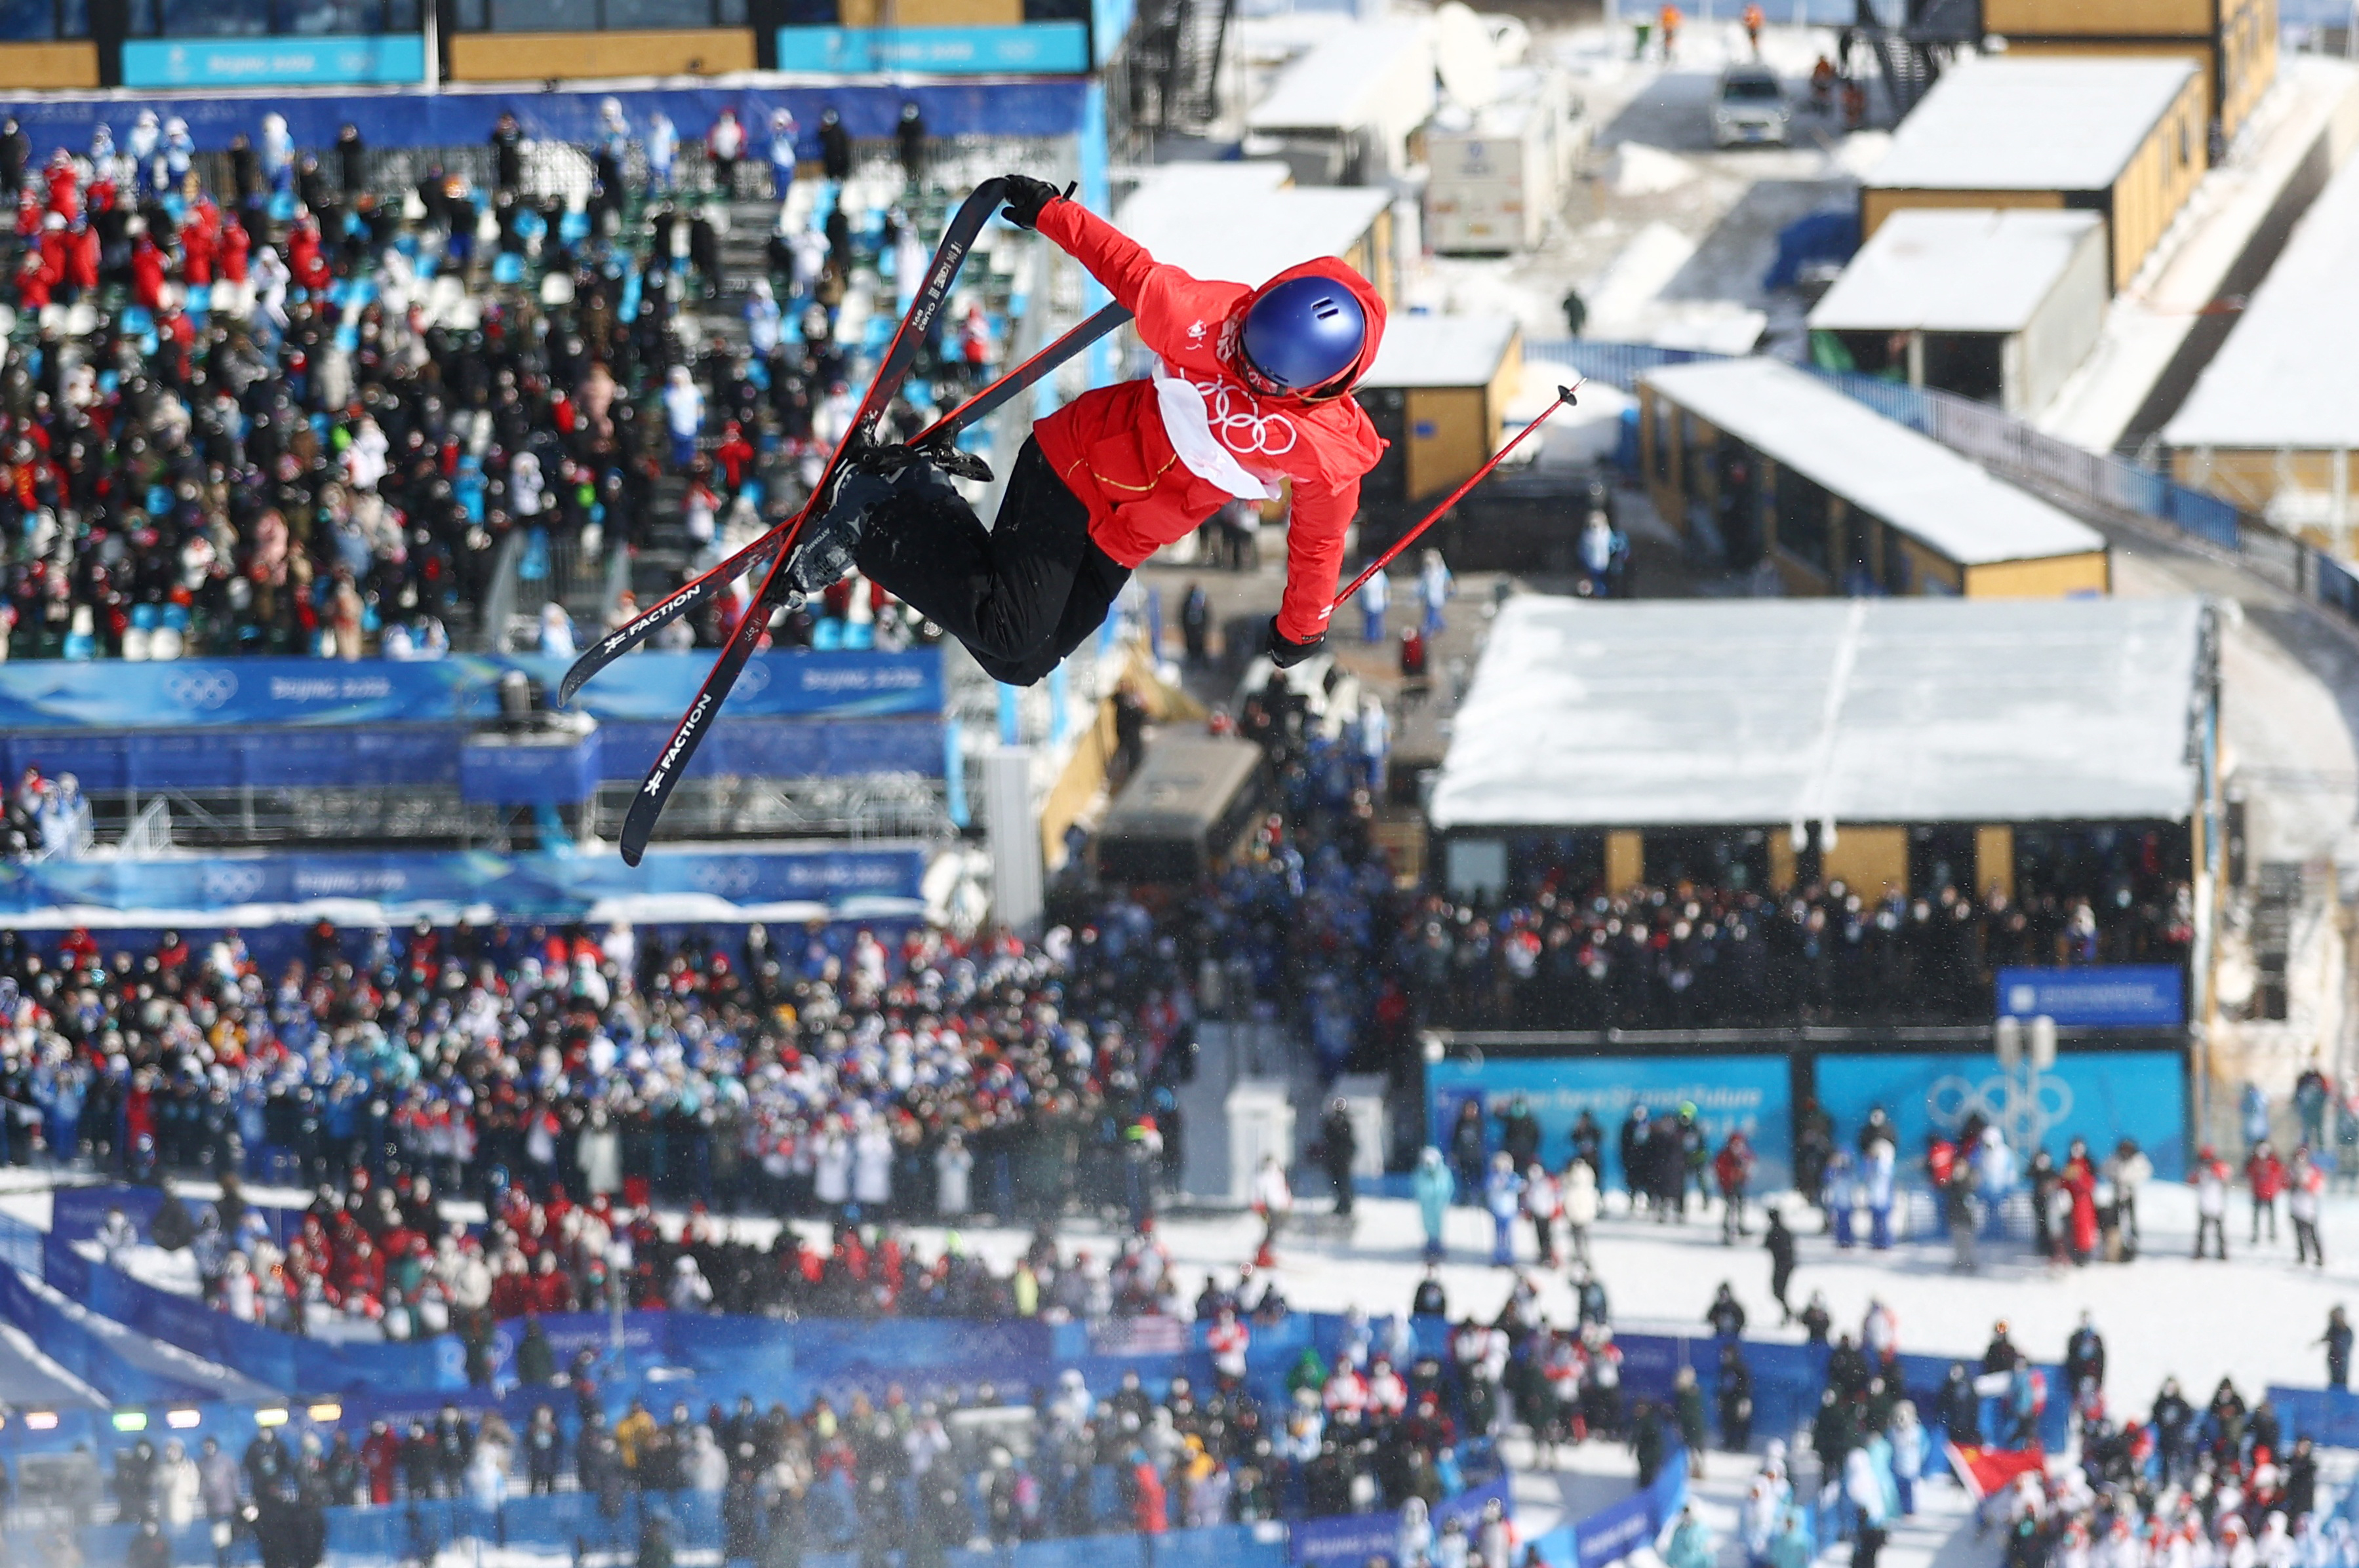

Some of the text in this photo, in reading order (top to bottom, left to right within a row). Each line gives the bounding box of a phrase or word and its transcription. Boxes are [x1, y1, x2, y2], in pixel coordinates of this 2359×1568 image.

[805, 527, 831, 554] ATOMIC
[629, 584, 701, 636] FACTION
[664, 693, 713, 770] FACTION
